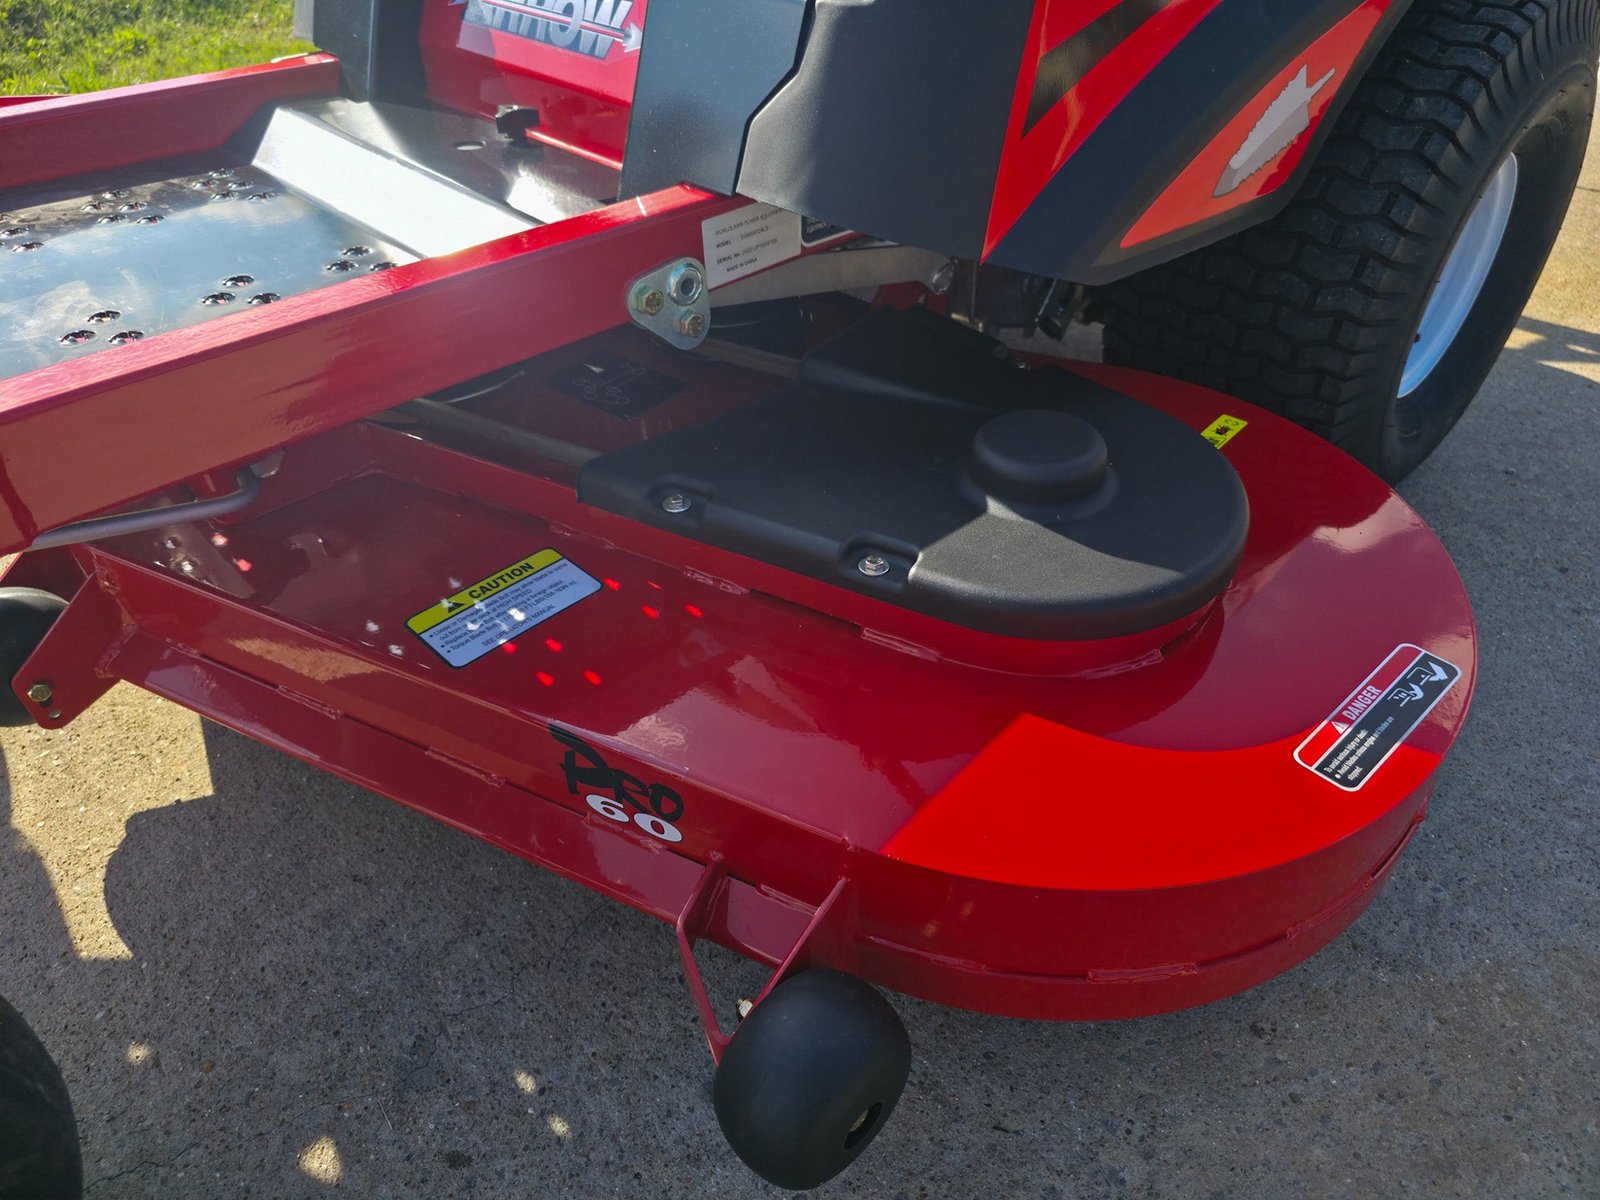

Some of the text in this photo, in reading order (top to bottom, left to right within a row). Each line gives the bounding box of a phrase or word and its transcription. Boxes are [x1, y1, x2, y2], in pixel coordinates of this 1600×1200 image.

[744, 215, 760, 225] POWER
[715, 239, 732, 248] MODEL
[717, 254, 733, 264] SERIAL
[726, 264, 738, 272] MADE
[744, 257, 758, 265] CHINA
[467, 562, 535, 599] CAUTION
[432, 624, 452, 635] Loose
[456, 607, 485, 623] Damage
[443, 631, 469, 645] Replace
[529, 588, 548, 599] foreign
[447, 625, 463, 635] from
[460, 617, 478, 628] uder
[495, 599, 513, 609] HIGH
[510, 588, 533, 600] SPEED
[481, 636, 497, 646] SEE
[530, 603, 556, 618] MANUAL
[450, 637, 471, 650] Torque
[468, 629, 487, 639] Blade
[1342, 685, 1382, 720] DANGER
[1328, 760, 1340, 768] avoid
[1336, 749, 1349, 760] serious
[1346, 741, 1358, 750] injury
[1337, 765, 1349, 774] Avoid
[1345, 755, 1358, 765] blades
[1354, 746, 1367, 755] unless
[1363, 736, 1377, 747] engine
[1377, 722, 1389, 731] blades
[586, 794, 683, 843] 60
